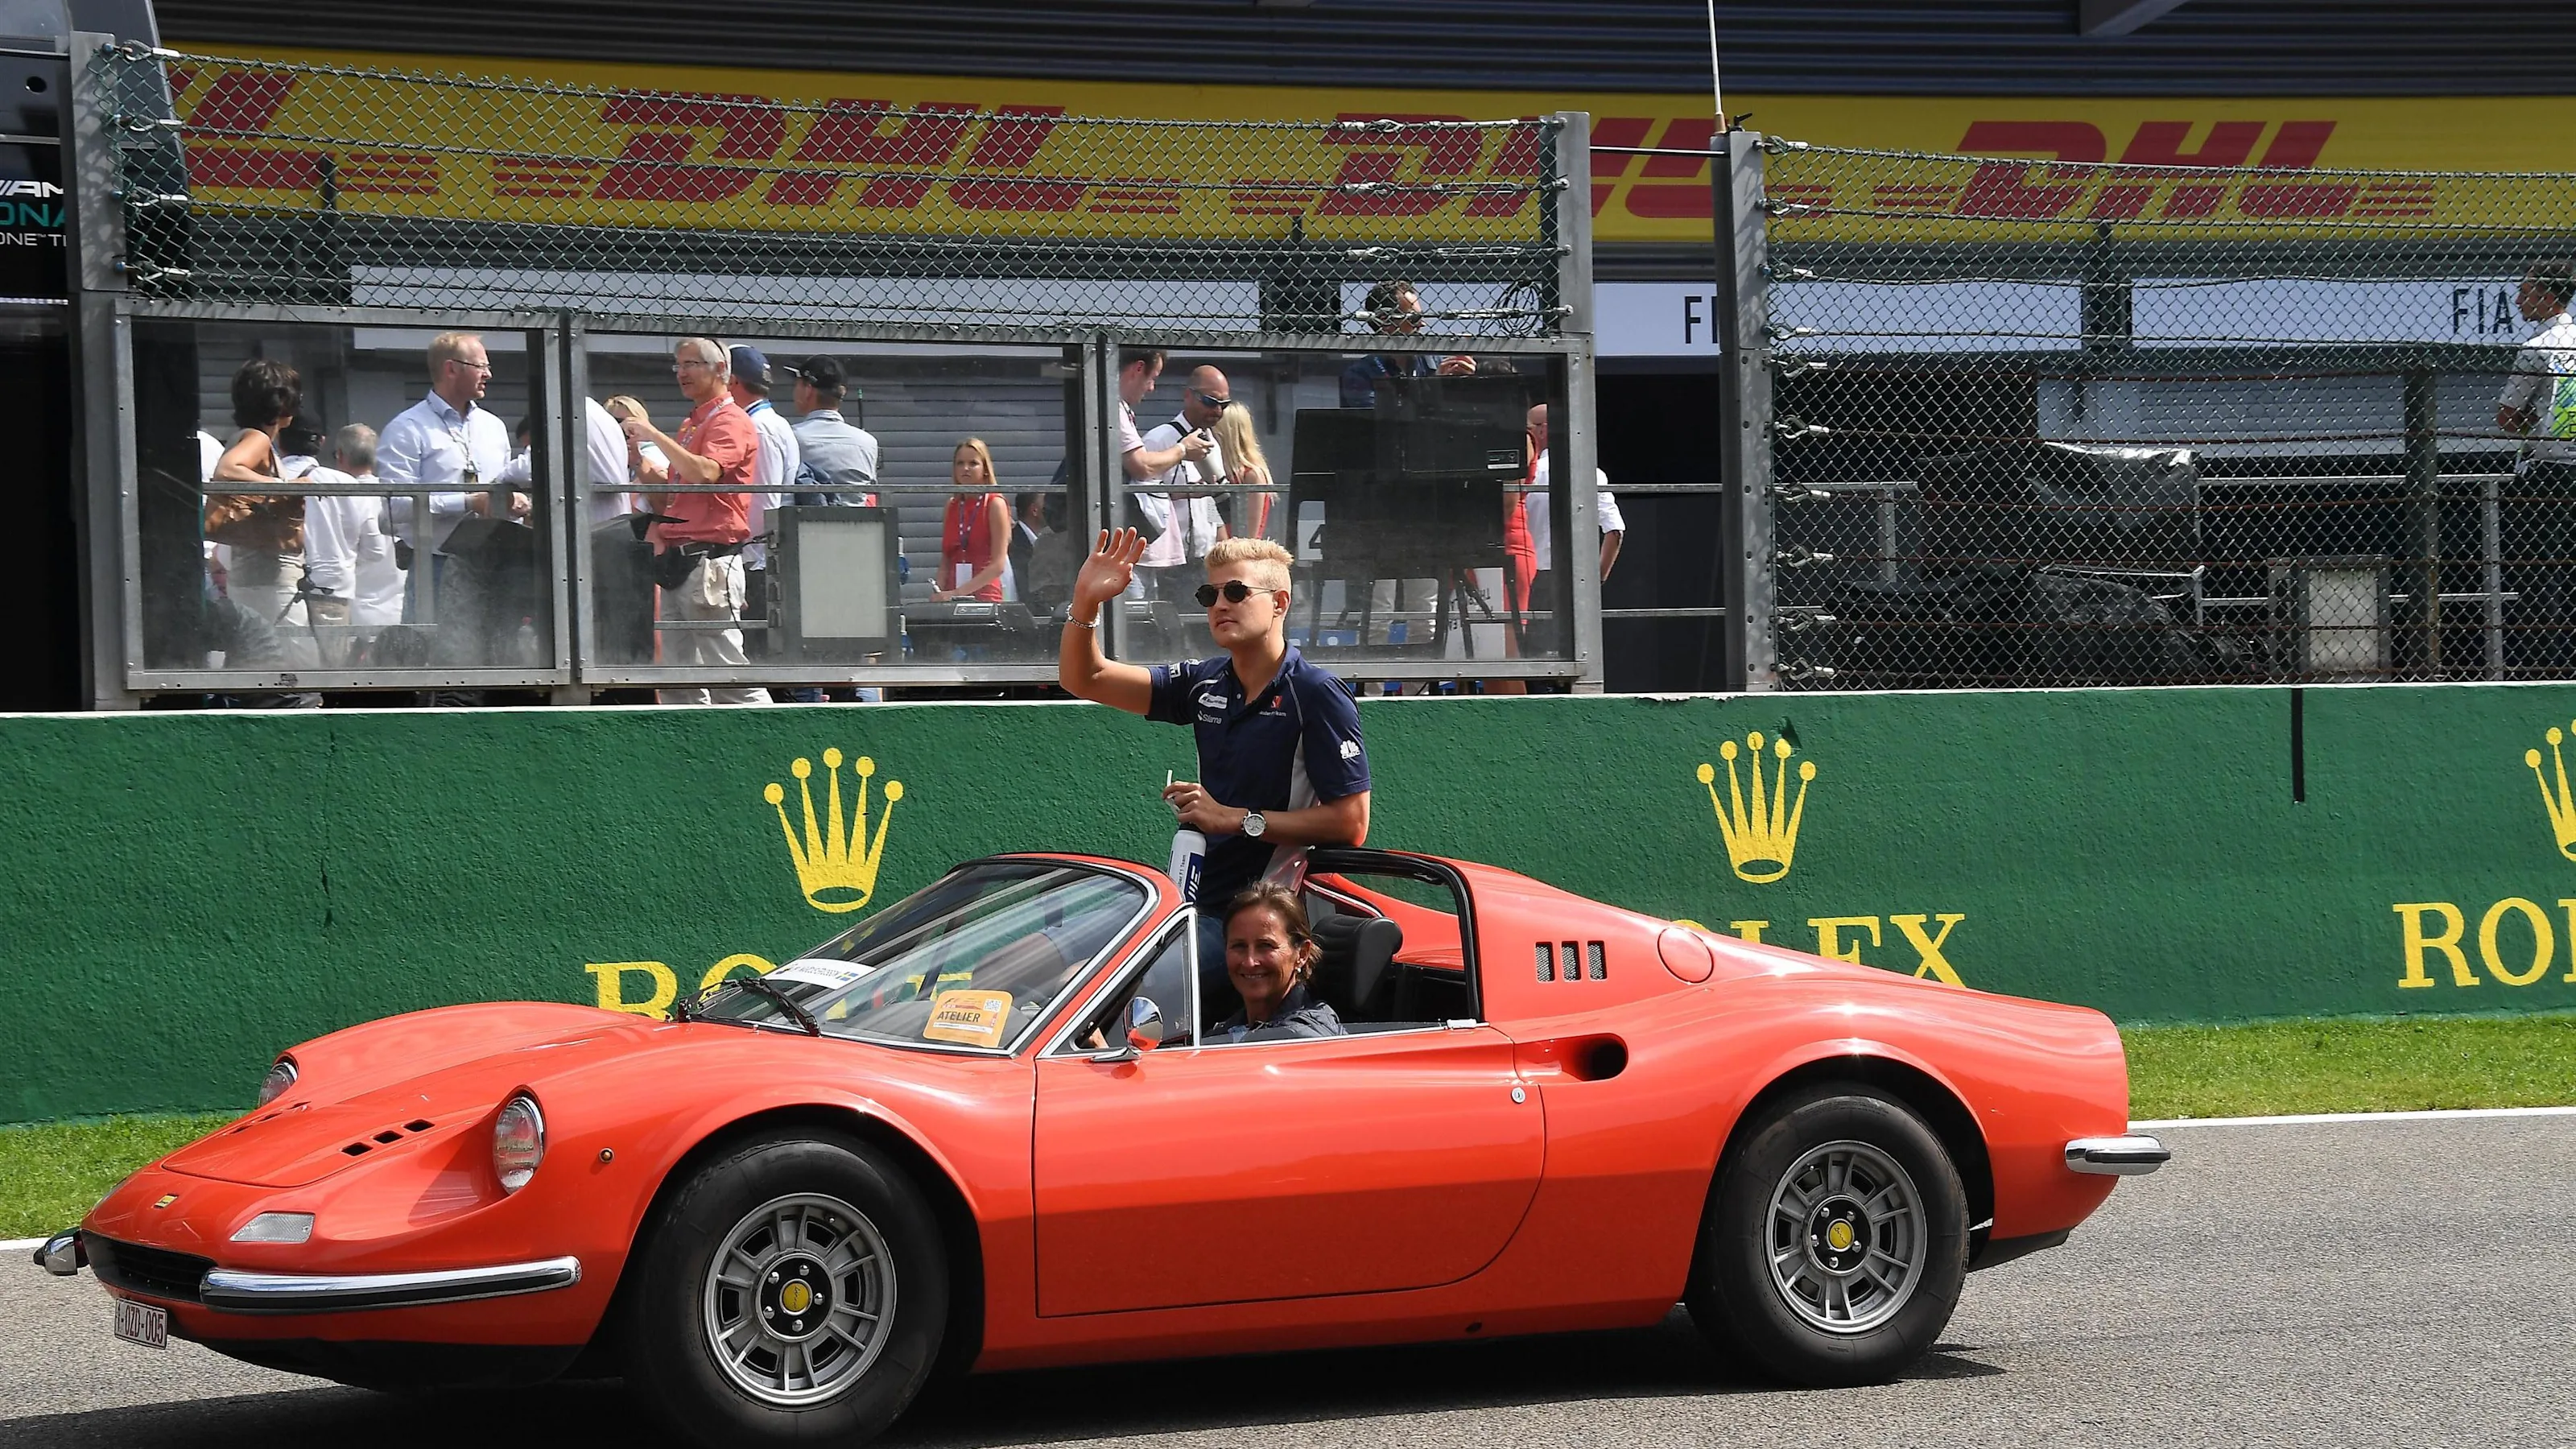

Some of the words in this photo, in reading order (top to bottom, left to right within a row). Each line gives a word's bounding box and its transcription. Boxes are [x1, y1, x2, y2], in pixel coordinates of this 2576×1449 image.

[593, 89, 1088, 212] DHL
[1315, 113, 1712, 219] DHL
[1951, 120, 2359, 217] DHL
[2453, 287, 2514, 334] FIA
[2392, 896, 2576, 989] RO
[936, 1010, 981, 1023] ATELIER
